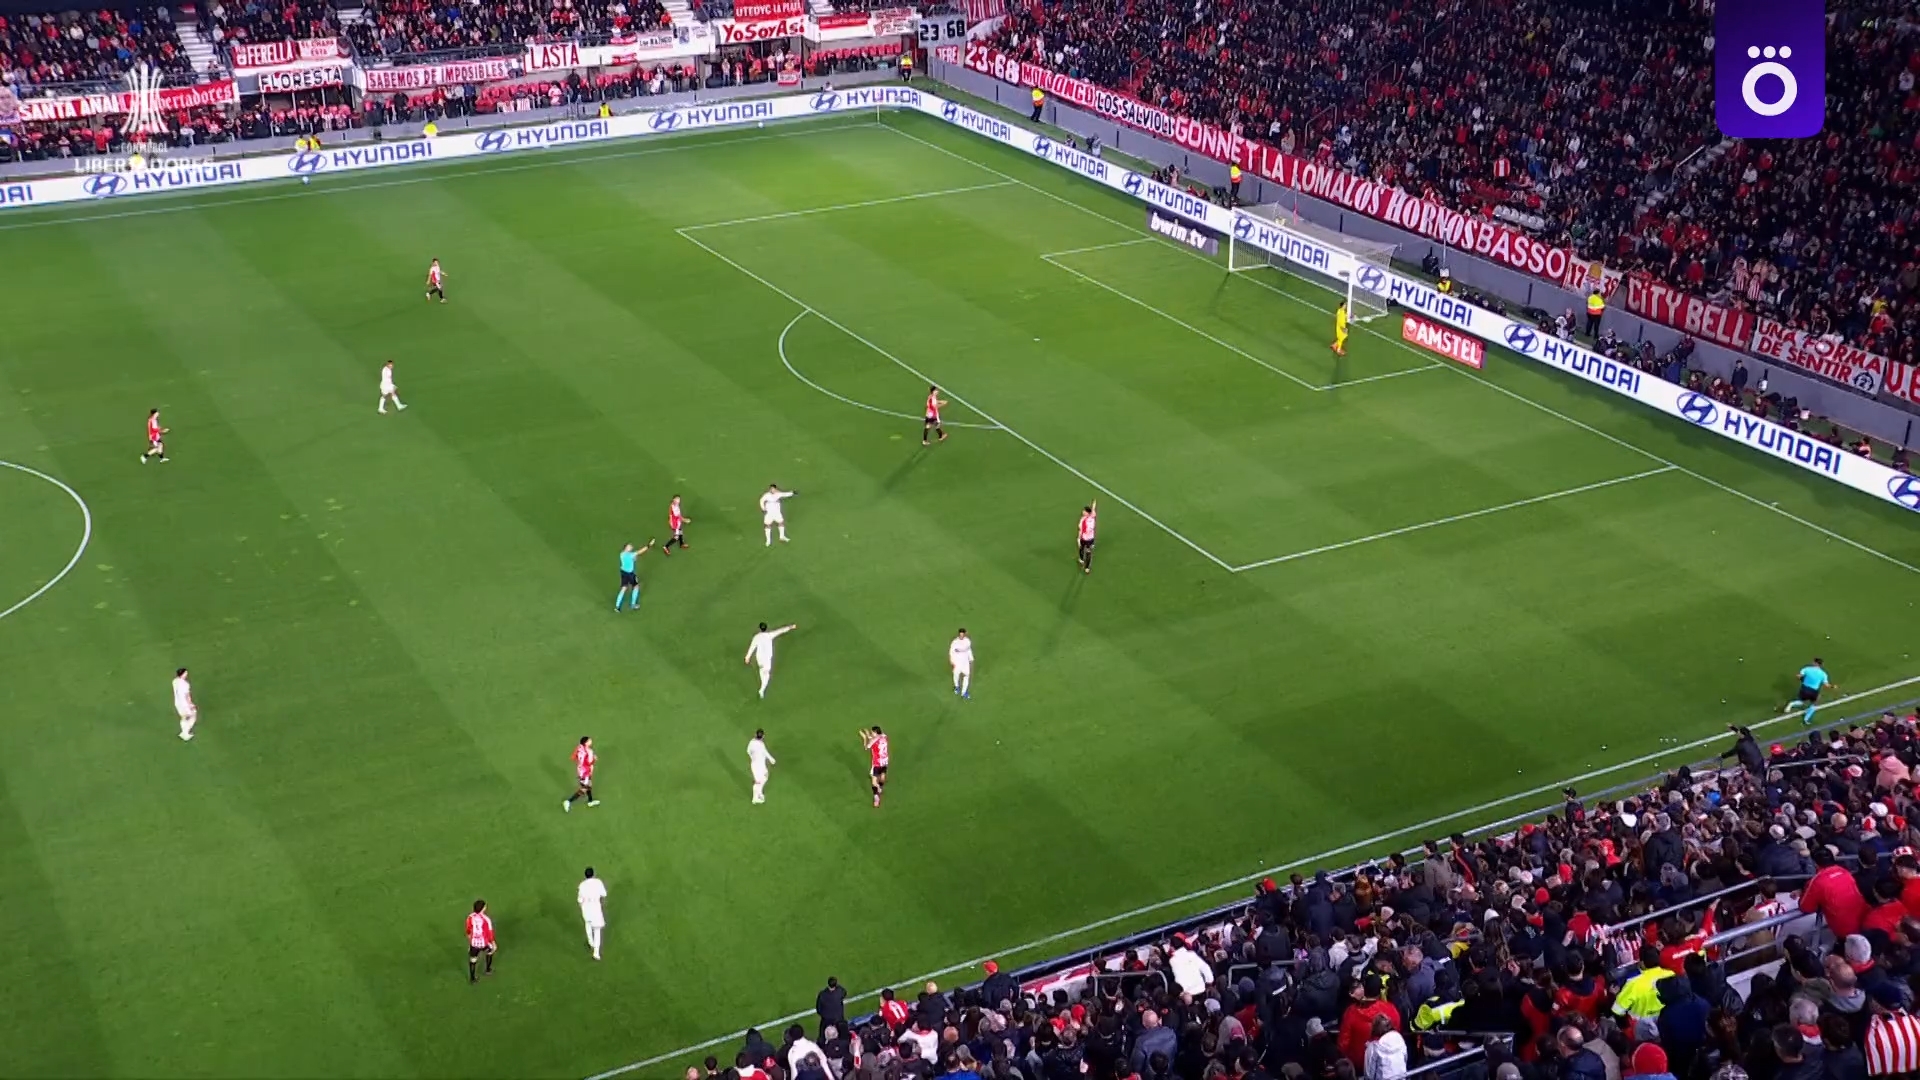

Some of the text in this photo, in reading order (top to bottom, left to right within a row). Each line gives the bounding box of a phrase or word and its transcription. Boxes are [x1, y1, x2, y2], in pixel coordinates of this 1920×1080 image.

[919, 24, 940, 41] 23
[369, 60, 505, 89] SABEMOS DE IMPOSIBLES
[530, 44, 580, 69] LASTA
[261, 67, 342, 89] FLORESTA
[19, 101, 76, 121] SANTA
[688, 102, 773, 124] HYUNDAI
[847, 89, 921, 107] HYUNDAI
[1097, 91, 1172, 136] LOS SALVIOLI
[517, 121, 609, 146] HYUNDAI
[962, 110, 1011, 141] HYUNDAI
[1175, 117, 1260, 170] GONNET
[334, 142, 432, 167] HYUNDAI
[1055, 146, 1109, 180] HYUNDAI
[1262, 149, 1284, 183] LA
[135, 164, 242, 190] HYUNDAI
[1147, 182, 1208, 221] HYUNDAI
[1385, 188, 1475, 250] HORNOS
[1150, 212, 1206, 249] bwin.tv
[1259, 227, 1329, 270] HYUNDAI
[1477, 228, 1567, 279] BASSO
[1390, 279, 1473, 327] HYUNDAI
[1627, 278, 1747, 348] CITY BELL
[1416, 322, 1480, 366] AMSTEL
[1758, 336, 1853, 384] DE SENTIR
[1759, 318, 1881, 374] UNA FORMA
[1543, 338, 1641, 394] HYUNDAI
[1724, 409, 1842, 475] HYUNDAI
